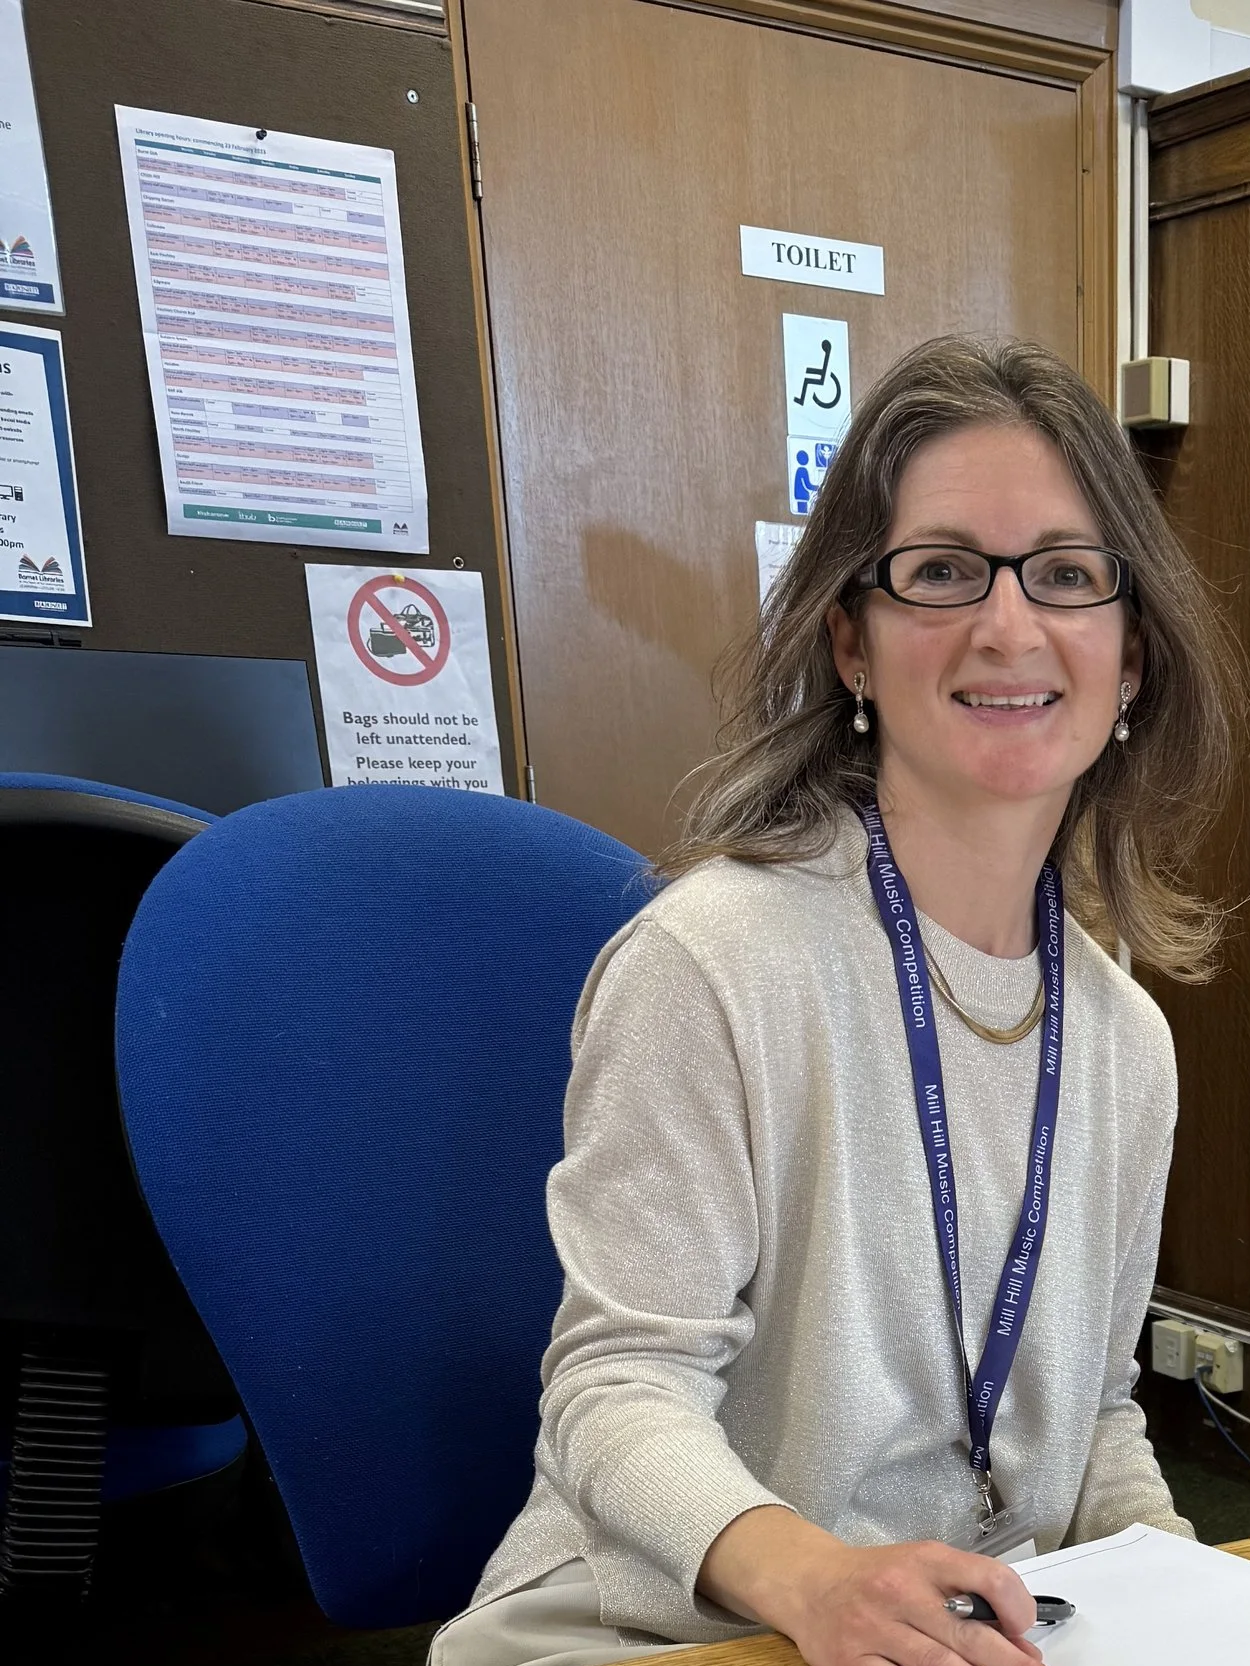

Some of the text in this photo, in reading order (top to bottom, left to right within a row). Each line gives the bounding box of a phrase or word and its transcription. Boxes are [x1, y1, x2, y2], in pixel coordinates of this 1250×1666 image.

[771, 242, 857, 274] TOILET
[343, 712, 479, 728] Bags should not be
[356, 732, 471, 746] left unattended.
[356, 756, 477, 773] Please keep your
[430, 777, 460, 788] with
[464, 780, 488, 790] you
[863, 804, 926, 1029] Mill Hill Music Competition
[1043, 863, 1060, 1076] Mill Hill Music Competition
[925, 1084, 961, 1310] Mill Hill Music Competition
[997, 1125, 1050, 1336] Mill Hill Music Competition
